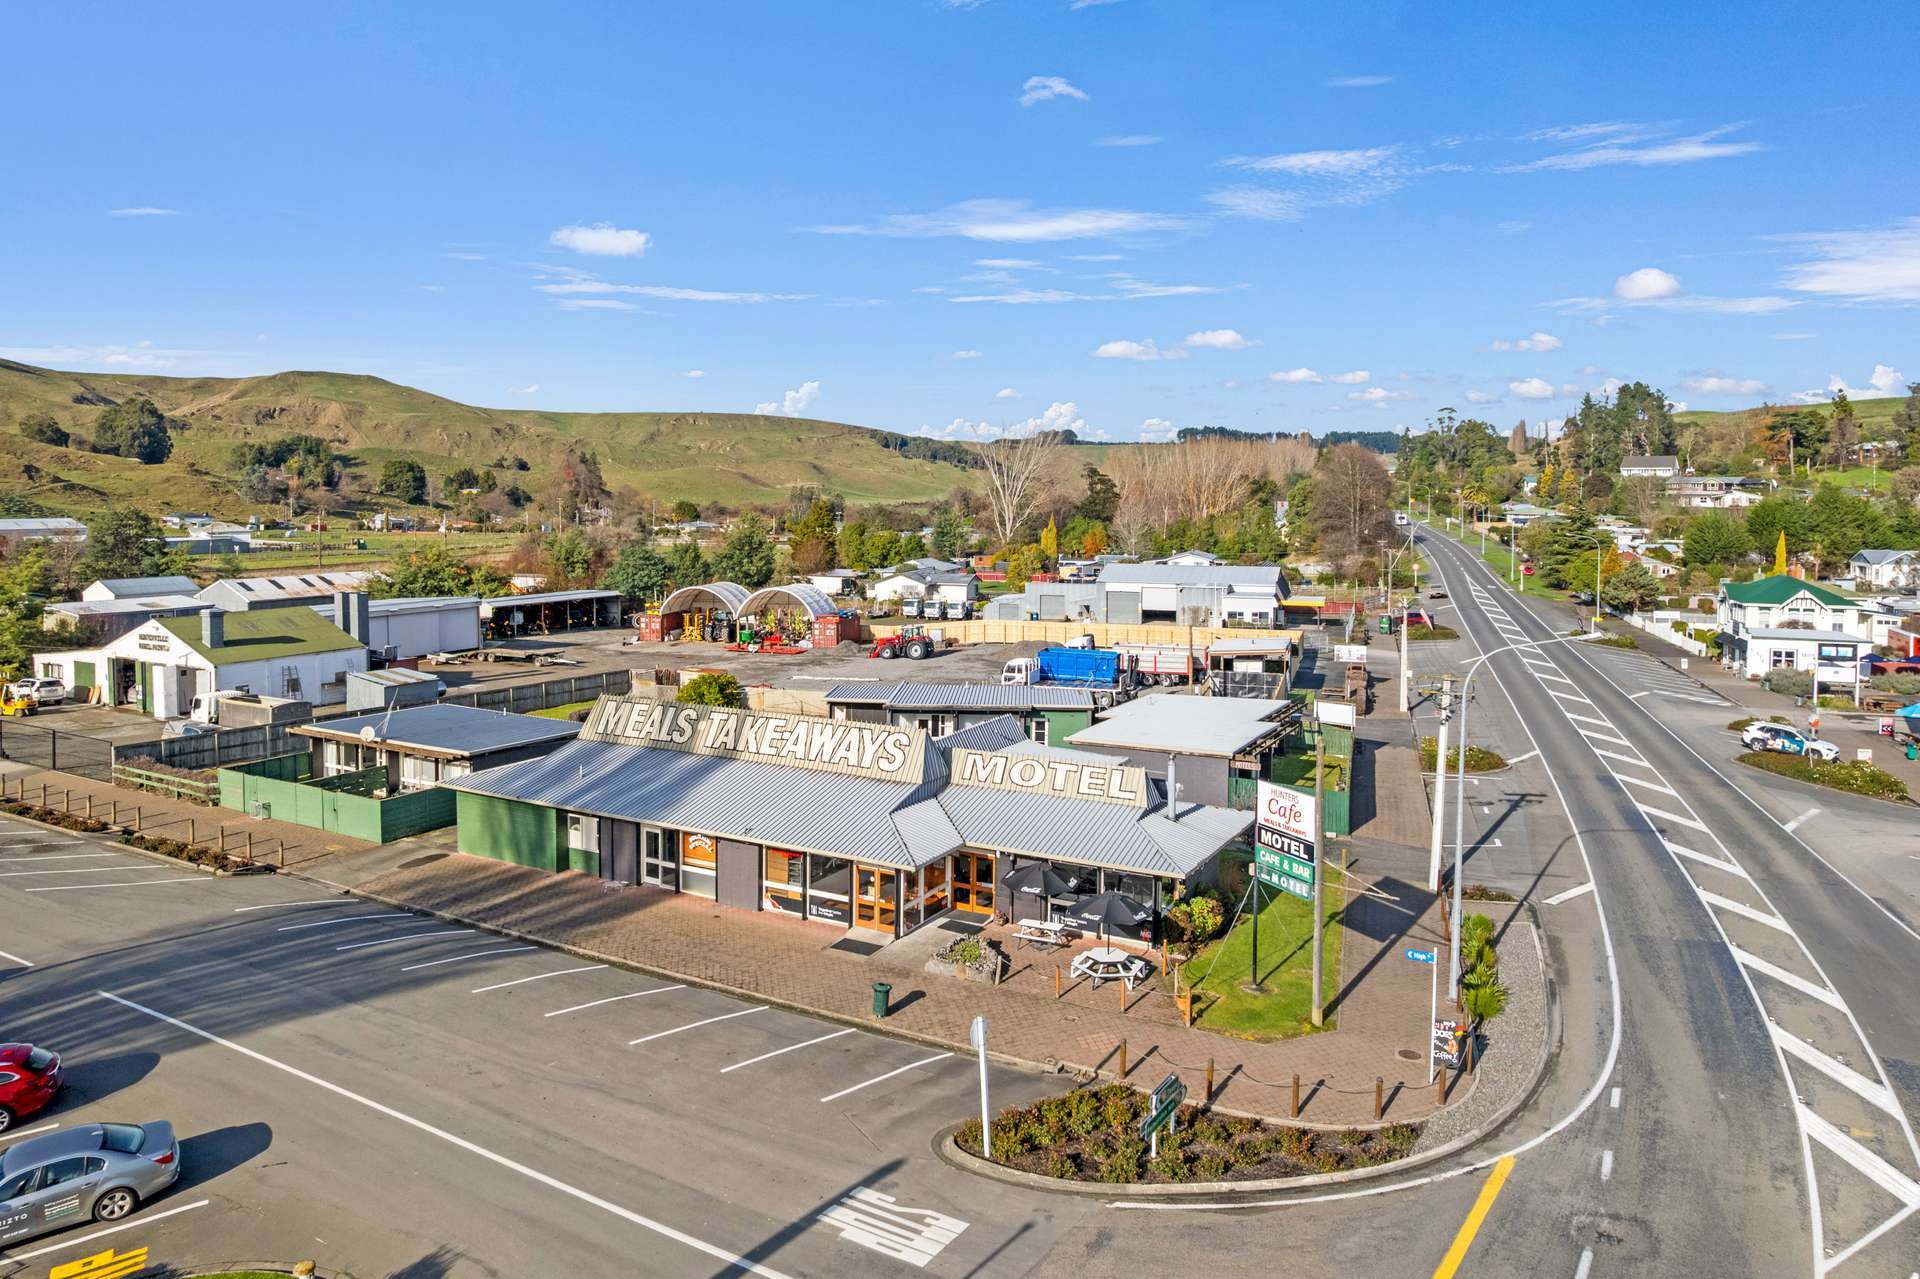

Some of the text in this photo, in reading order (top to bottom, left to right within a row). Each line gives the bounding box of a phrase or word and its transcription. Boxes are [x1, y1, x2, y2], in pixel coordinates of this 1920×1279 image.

[595, 700, 699, 744] MEALS
[961, 752, 1138, 801] MOTEL
[1270, 787, 1300, 805] HUNTERS
[1268, 797, 1302, 825] Cafe
[1261, 829, 1308, 859] MOTEL
[1260, 850, 1310, 879] CAFE & BAR
[1271, 872, 1309, 897] MOTEL
[816, 1185, 970, 1268] STOP
